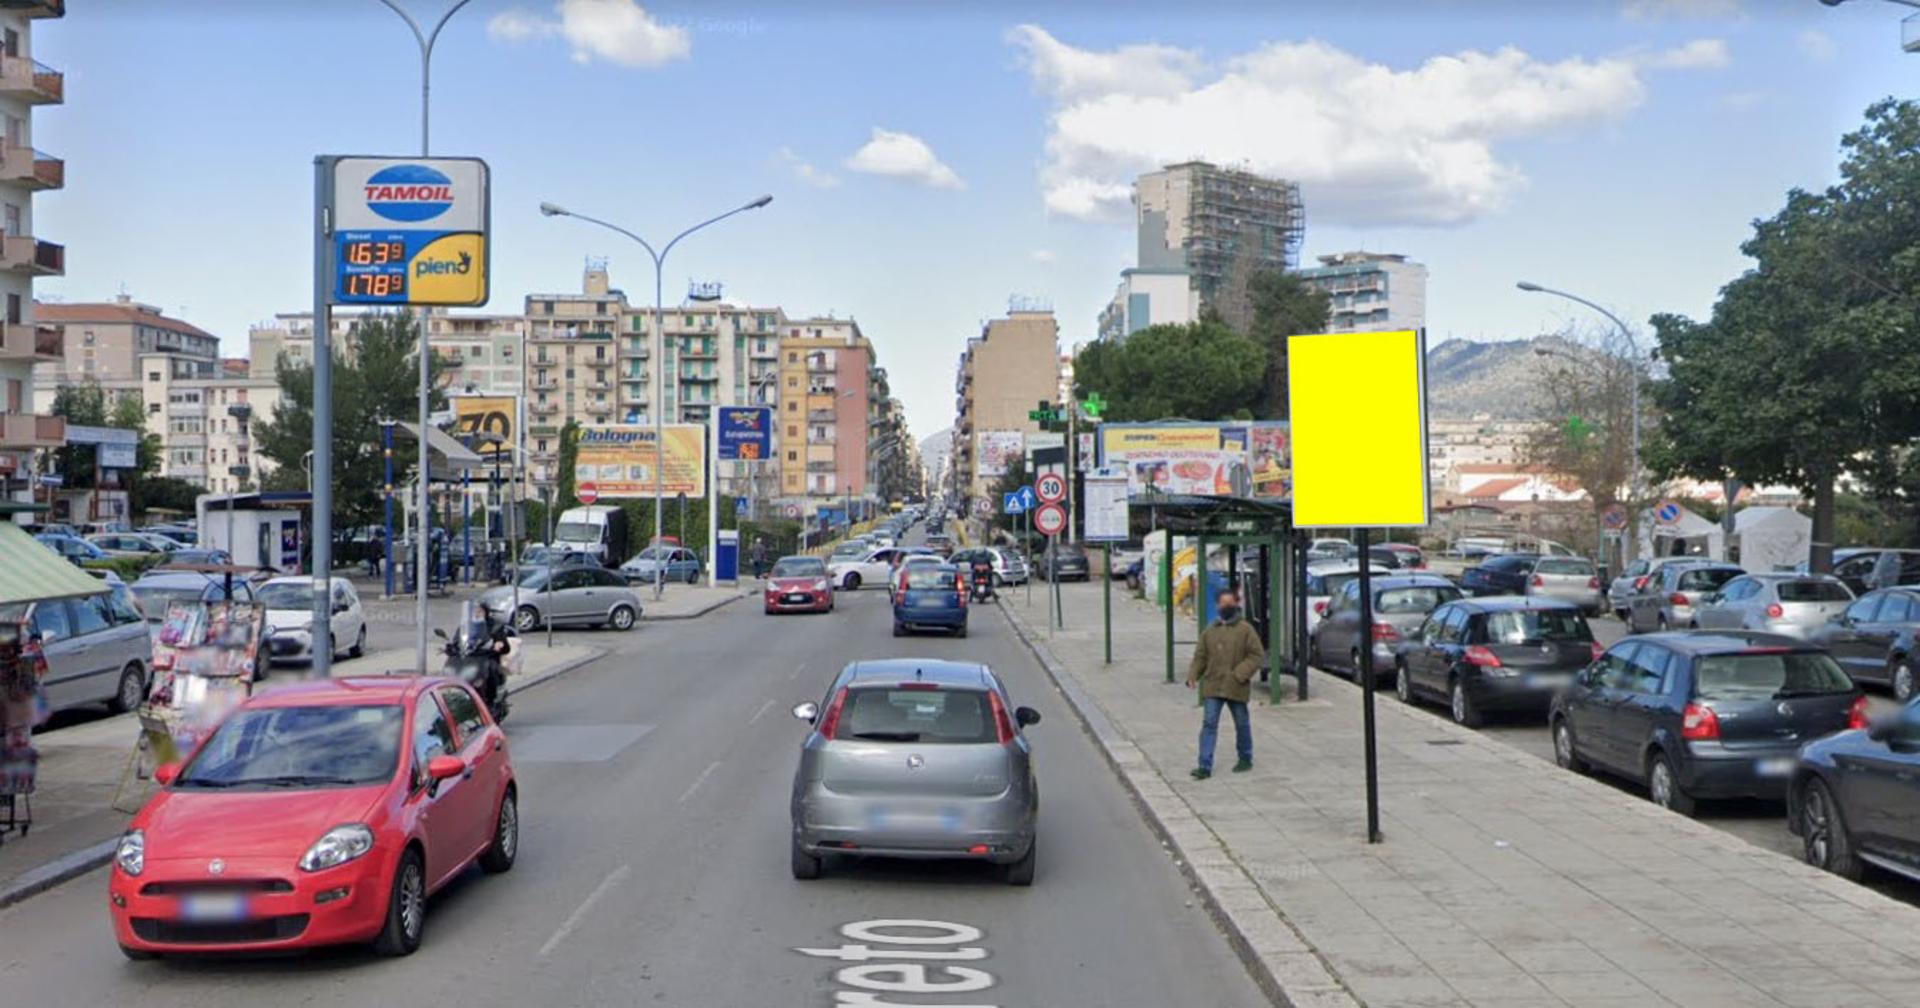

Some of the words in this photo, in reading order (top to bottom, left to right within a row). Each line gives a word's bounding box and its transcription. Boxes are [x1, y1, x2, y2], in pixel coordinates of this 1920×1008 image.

[363, 186, 455, 201] TAMOIL
[416, 256, 470, 278] pieno
[581, 428, 656, 443] Bologna
[1043, 481, 1060, 495] 30
